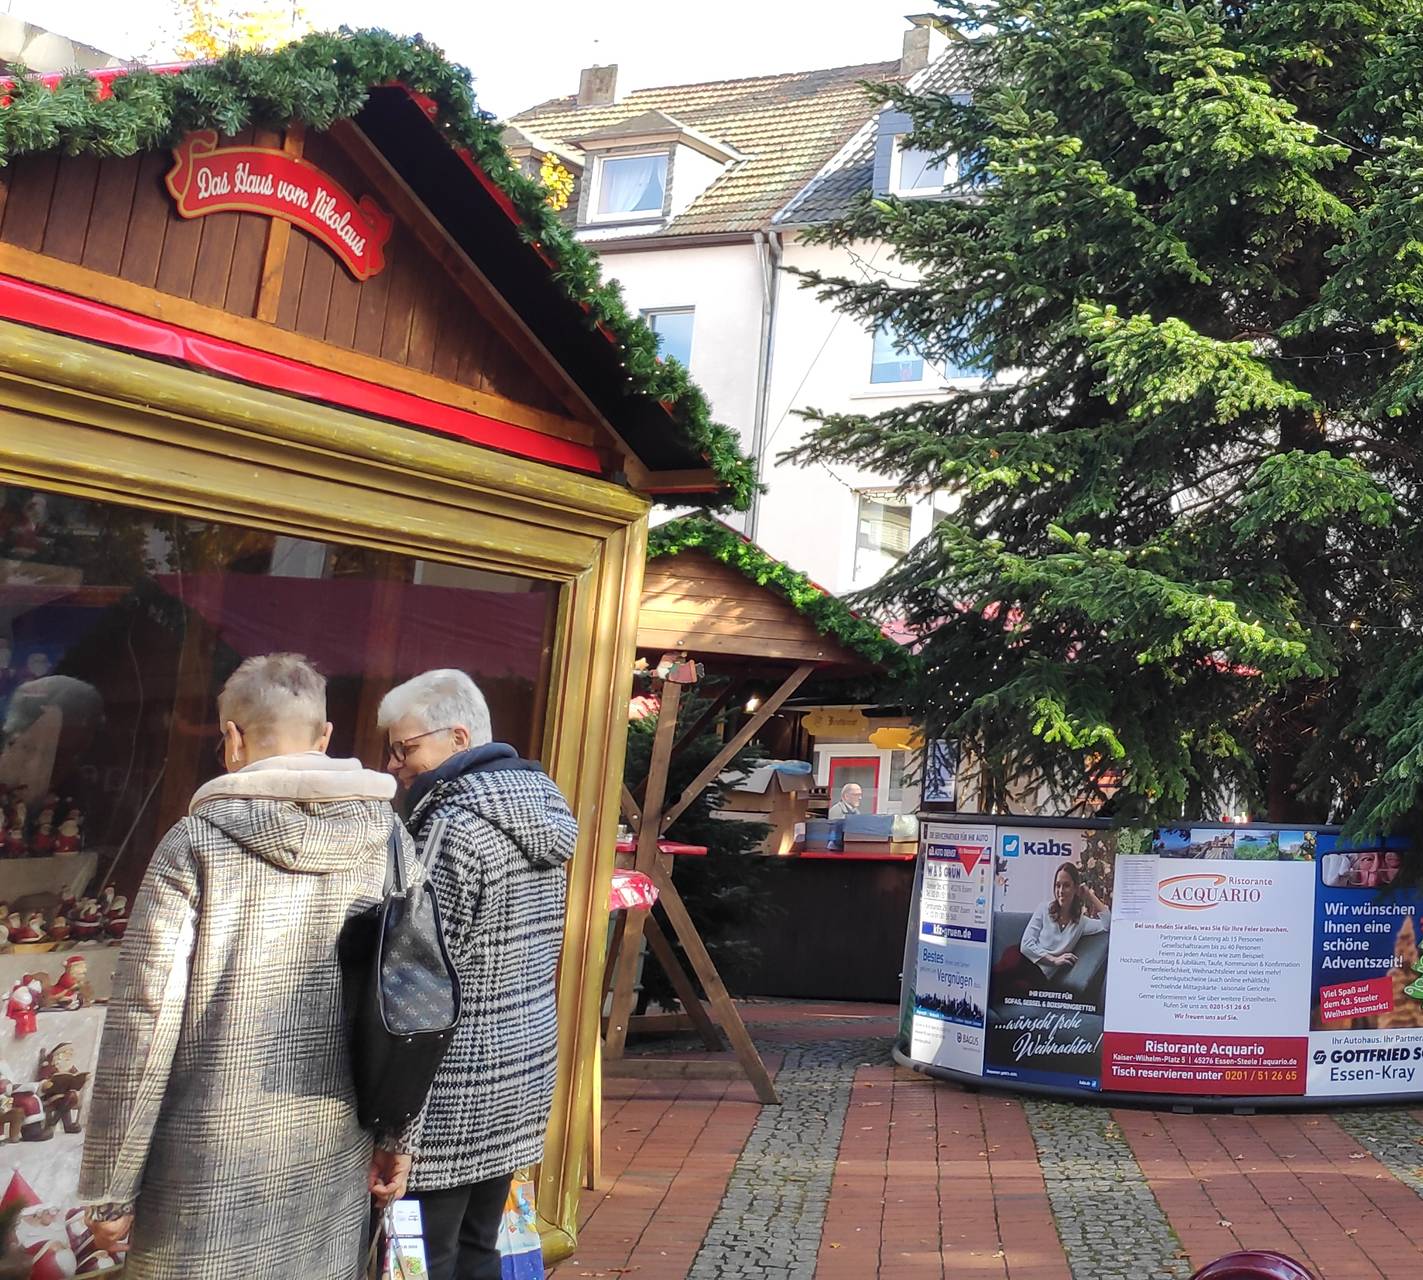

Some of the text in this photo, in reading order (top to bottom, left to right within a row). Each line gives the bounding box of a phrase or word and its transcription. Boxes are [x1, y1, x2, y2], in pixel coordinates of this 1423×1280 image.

[197, 162, 366, 257] Das Haus vom Nikolaus
[944, 864, 960, 879] GRÜN
[1229, 877, 1273, 886] Ristorante
[1171, 887, 1261, 903] ACQUARIO
[1325, 902, 1415, 915] Wir wünschen
[933, 923, 971, 939] kfz-gruen.de
[1324, 920, 1391, 933] Ihnen eine
[1198, 935, 1221, 943] Catering
[1323, 938, 1369, 951] schöne
[923, 948, 944, 964] Bestes
[1145, 958, 1175, 966] Geburtstag
[1322, 955, 1403, 969] Adventszeit!
[937, 968, 973, 988] Vergnügen
[1039, 991, 1061, 999] EXPERTE
[1062, 992, 1073, 1000] FÜR
[1323, 984, 1369, 998] Viel Spaß auf
[1354, 994, 1378, 1004] Steeler
[1324, 1002, 1388, 1018] Weihnachtsmarkt!
[1048, 1011, 1082, 1040] frohe
[1013, 1032, 1104, 1061] Weihnachten!
[1332, 1037, 1343, 1045] Ihr
[1344, 1036, 1382, 1045] Autohaus.
[1146, 1040, 1264, 1057] Ristorante Acquario
[1330, 1048, 1410, 1063] GOTTFRIED
[1113, 1053, 1180, 1063] Kaiser-Wilhelm-Platz
[1194, 1056, 1213, 1064] 45276
[1263, 1058, 1297, 1066] aquario.de
[1112, 1066, 1136, 1076] Tisch
[1138, 1067, 1193, 1079] reservieren
[1196, 1071, 1223, 1080] unter
[1225, 1071, 1247, 1080] 0201
[1258, 1071, 1268, 1080] 51
[1272, 1071, 1282, 1080] 26
[1285, 1072, 1297, 1080] 65
[1330, 1065, 1416, 1082] Essen-Kray
